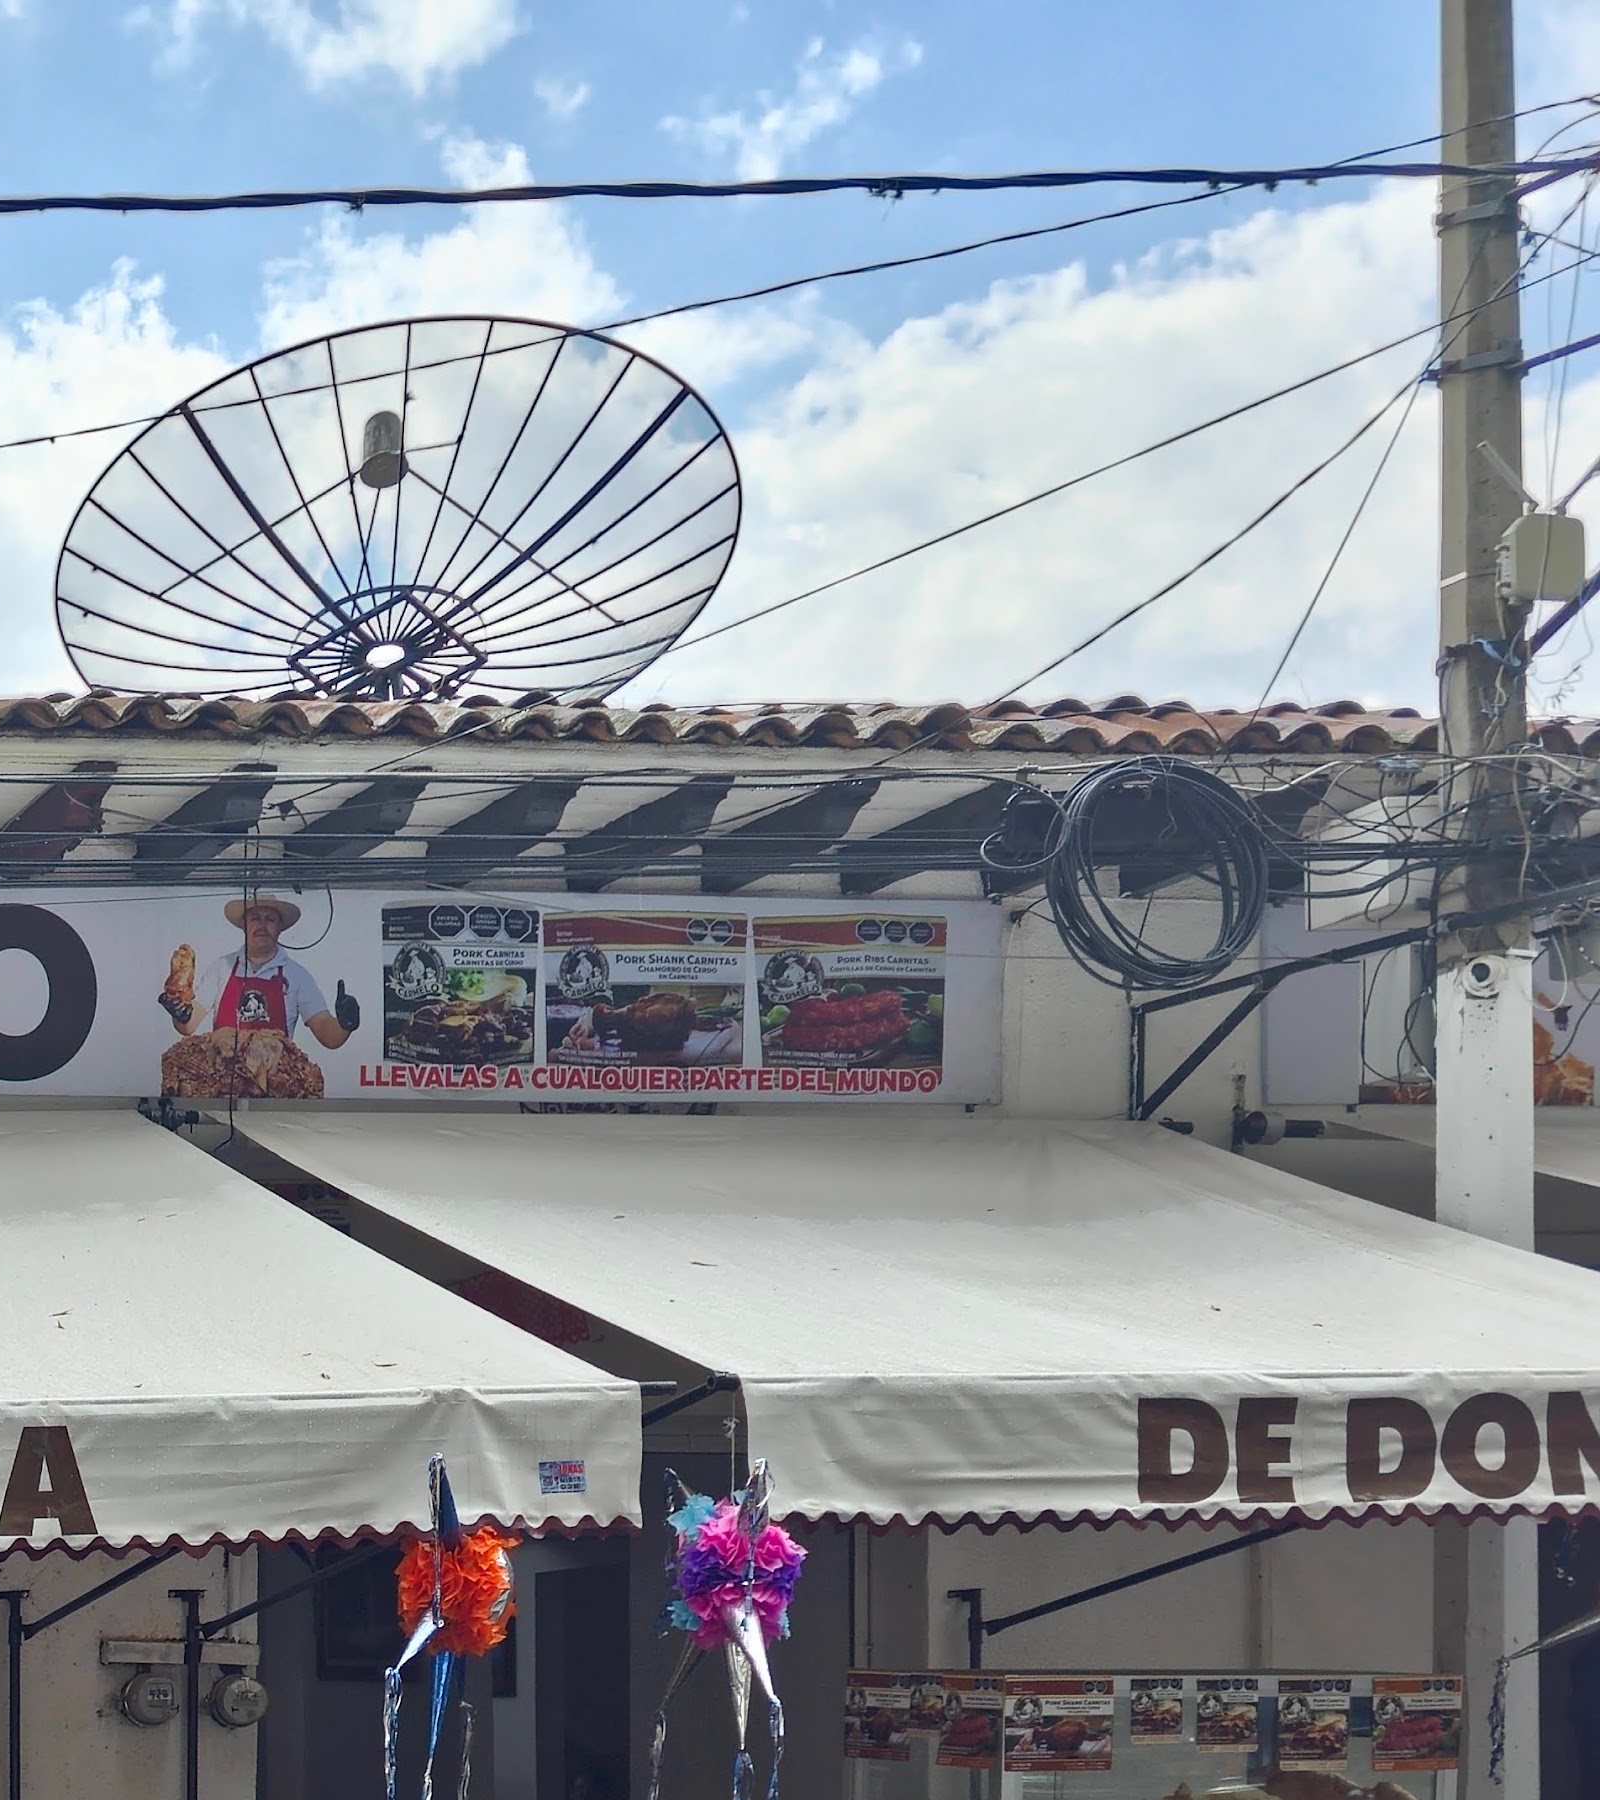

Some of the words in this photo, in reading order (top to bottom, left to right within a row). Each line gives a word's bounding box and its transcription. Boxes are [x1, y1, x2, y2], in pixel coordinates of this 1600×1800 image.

[453, 948, 483, 958] PORK
[485, 949, 526, 959] CARNITAS
[616, 953, 646, 965] PORK
[648, 953, 685, 965] SHANK
[687, 954, 738, 966] CARNITAS
[837, 955, 862, 964] PORK
[864, 954, 886, 964] RIBS
[887, 955, 930, 965] CARNITAS
[454, 958, 494, 966] CARNITAS
[398, 983, 440, 998] CARMELO
[359, 1064, 498, 1089] LLEVALAS
[503, 1066, 525, 1089] A
[530, 1066, 684, 1092] CUALQUIER
[689, 1068, 774, 1092] PARTE
[780, 1068, 832, 1093] DEL
[835, 1069, 939, 1094] MUNDO
[1138, 1396, 1299, 1504] DE
